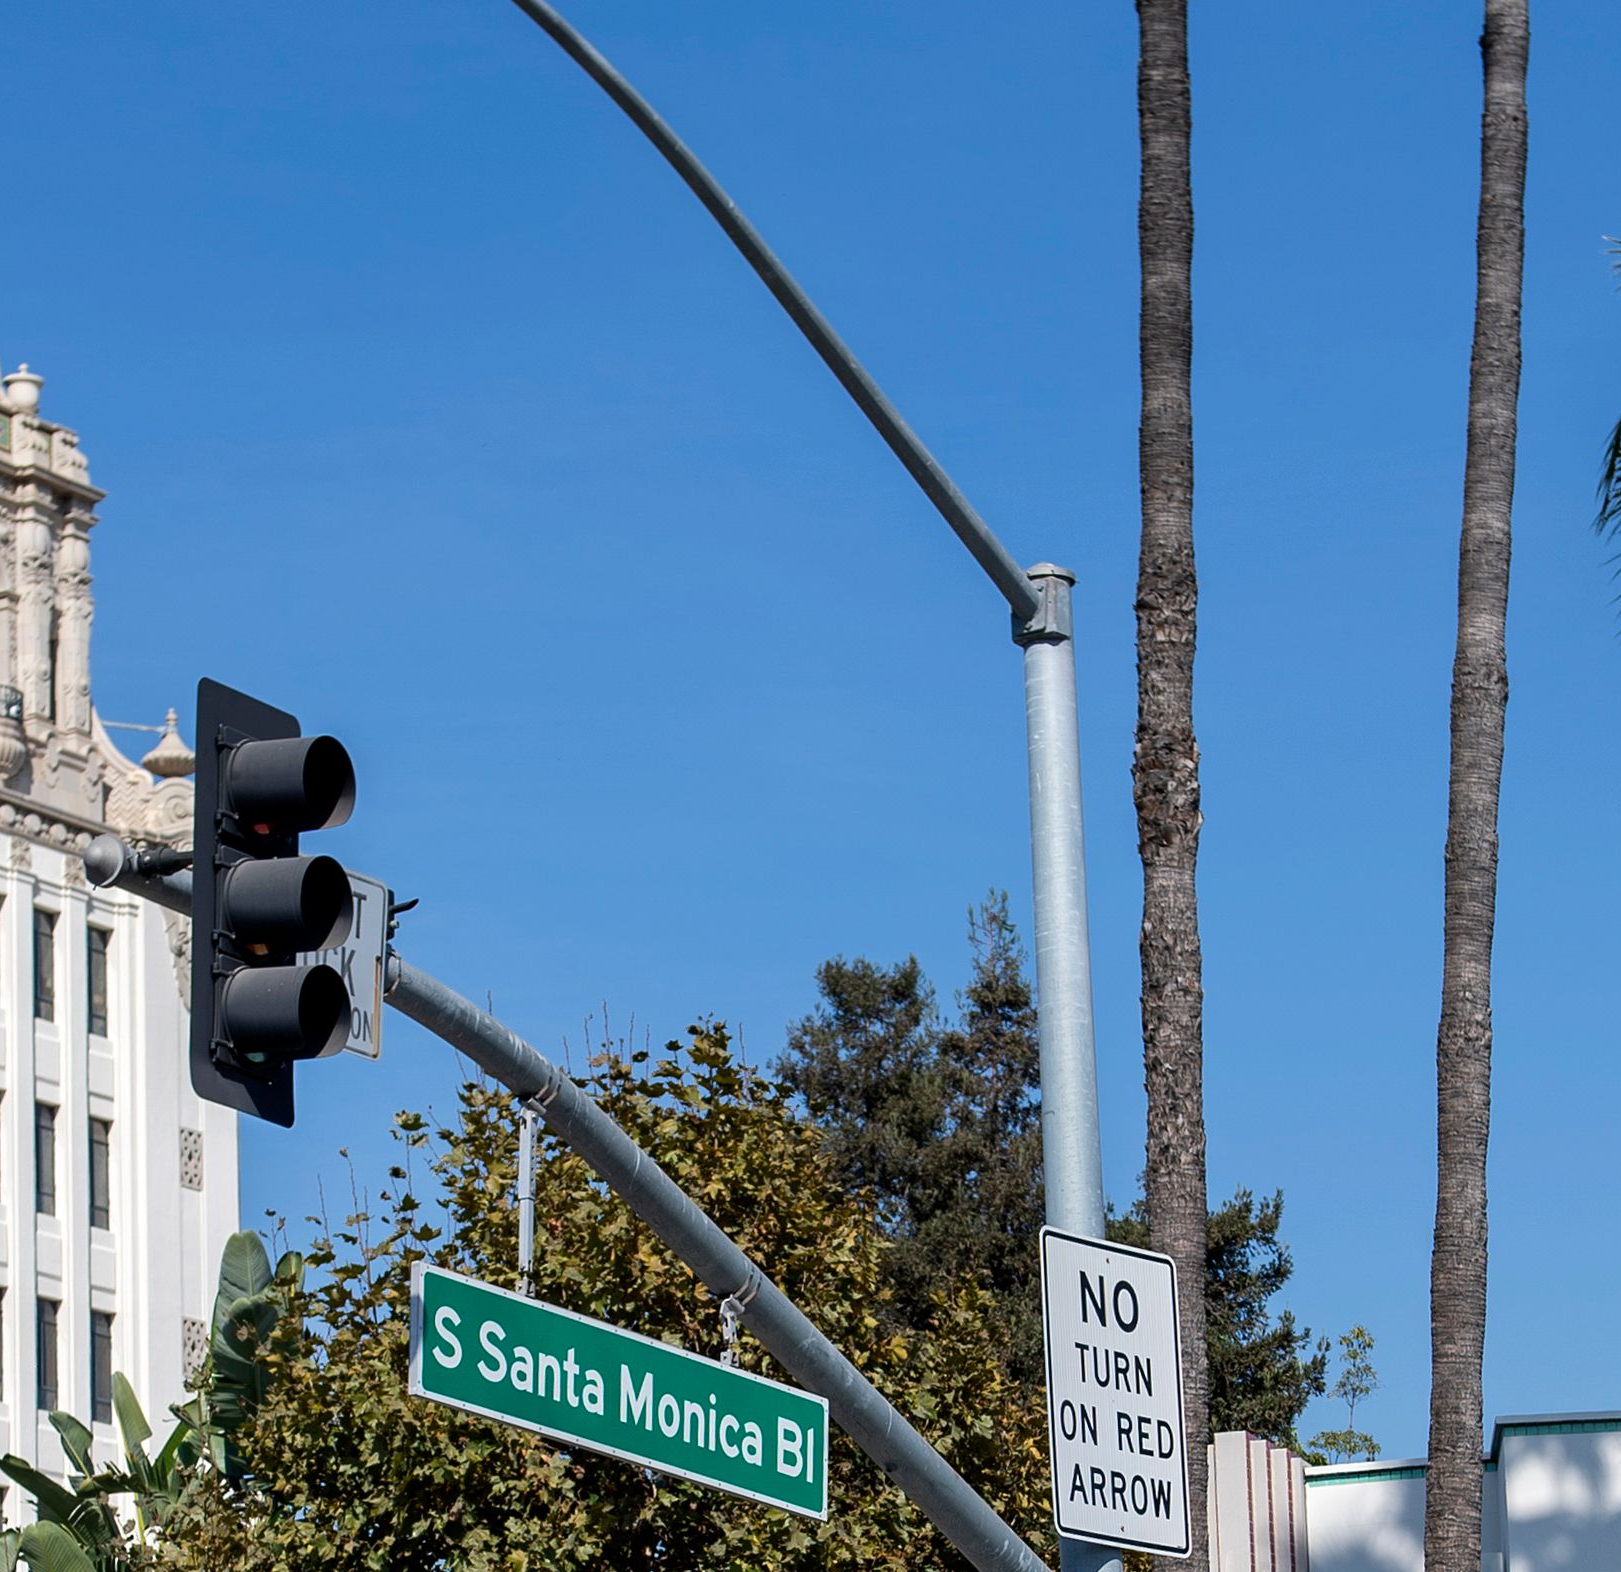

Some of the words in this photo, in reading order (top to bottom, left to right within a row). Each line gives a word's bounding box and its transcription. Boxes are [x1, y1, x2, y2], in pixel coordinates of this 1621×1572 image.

[1079, 1270, 1139, 1333] NO
[432, 1305, 463, 1369] S
[477, 1320, 605, 1416] Santa
[620, 1363, 763, 1467] Monica
[776, 1416, 815, 1484] Bl
[1074, 1341, 1153, 1398] TURN
[1060, 1399, 1098, 1446] ON
[1116, 1411, 1174, 1460] RED
[1069, 1463, 1172, 1520] ARROW
